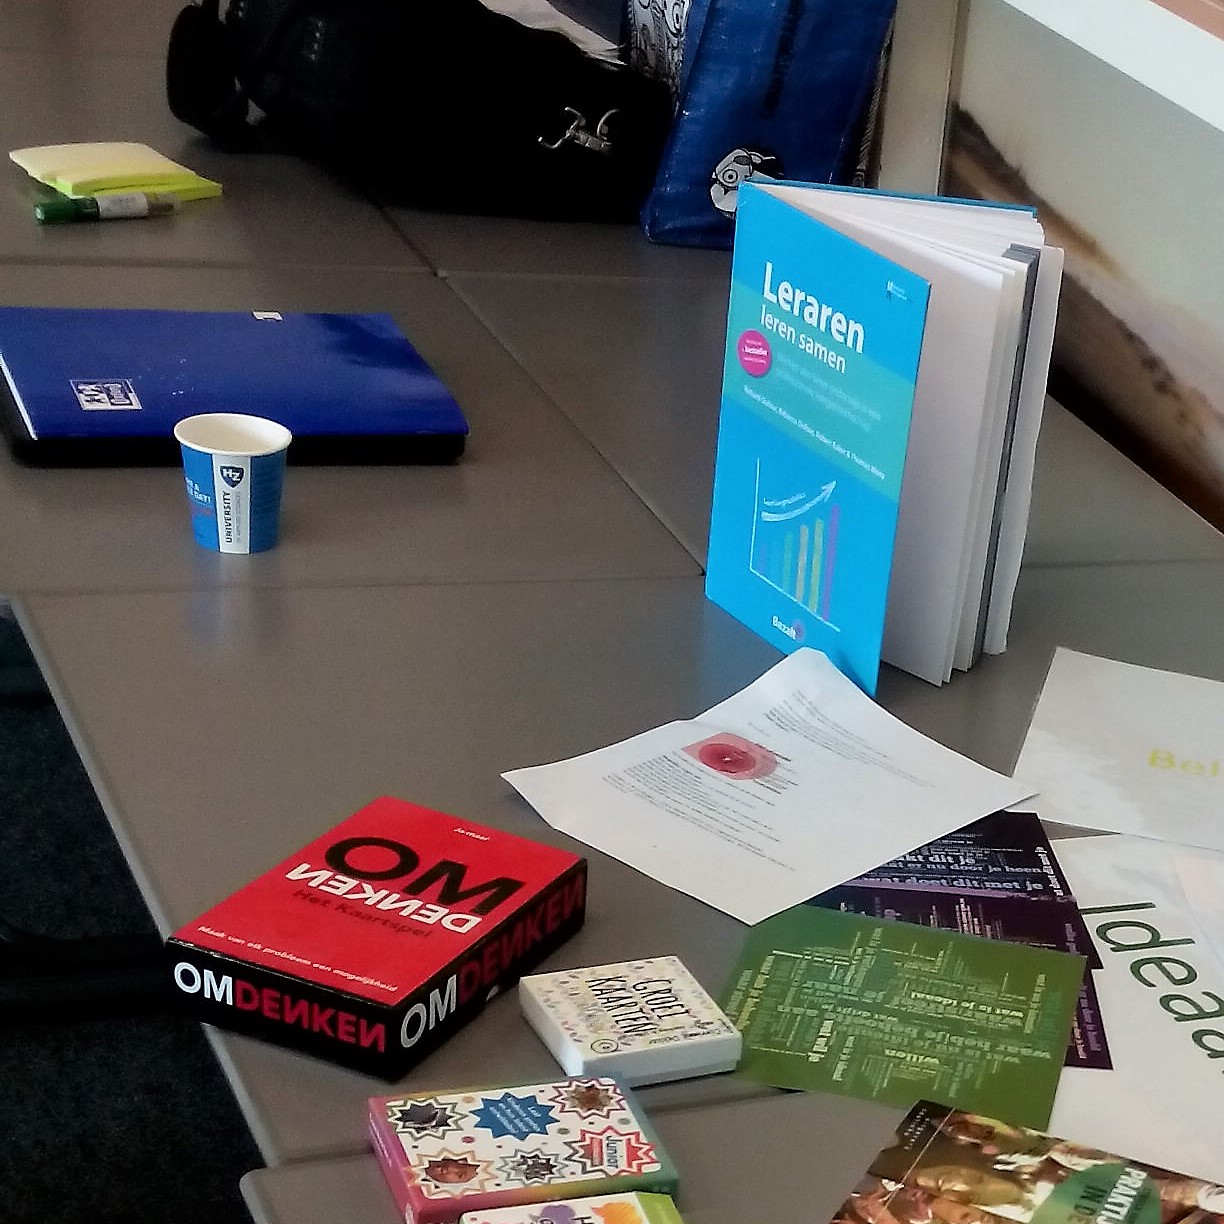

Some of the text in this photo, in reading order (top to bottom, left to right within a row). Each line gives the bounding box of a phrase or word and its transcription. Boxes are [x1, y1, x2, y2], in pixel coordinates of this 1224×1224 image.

[764, 262, 864, 353] Leraren
[761, 304, 795, 343] leren
[799, 333, 845, 373] samen
[222, 468, 241, 481] HZ
[223, 491, 232, 543] UNIVERSITY
[929, 854, 954, 864] dit
[959, 855, 975, 866] je
[950, 863, 984, 872] door
[988, 865, 1002, 874] je
[1005, 865, 1044, 874] heen
[325, 837, 525, 916] OM
[951, 878, 980, 888] dit
[984, 880, 1021, 889] met
[1027, 880, 1043, 891] je
[293, 890, 434, 938] Het Kaartspel
[263, 946, 311, 966] probleem
[585, 975, 657, 1034] KAARTEN
[633, 979, 690, 1021] GROEI
[910, 991, 1024, 1019] wat is je ideaal
[884, 1049, 940, 1063] willen
[605, 1135, 619, 1170] Junior
[1080, 1184, 1108, 1204] IN
